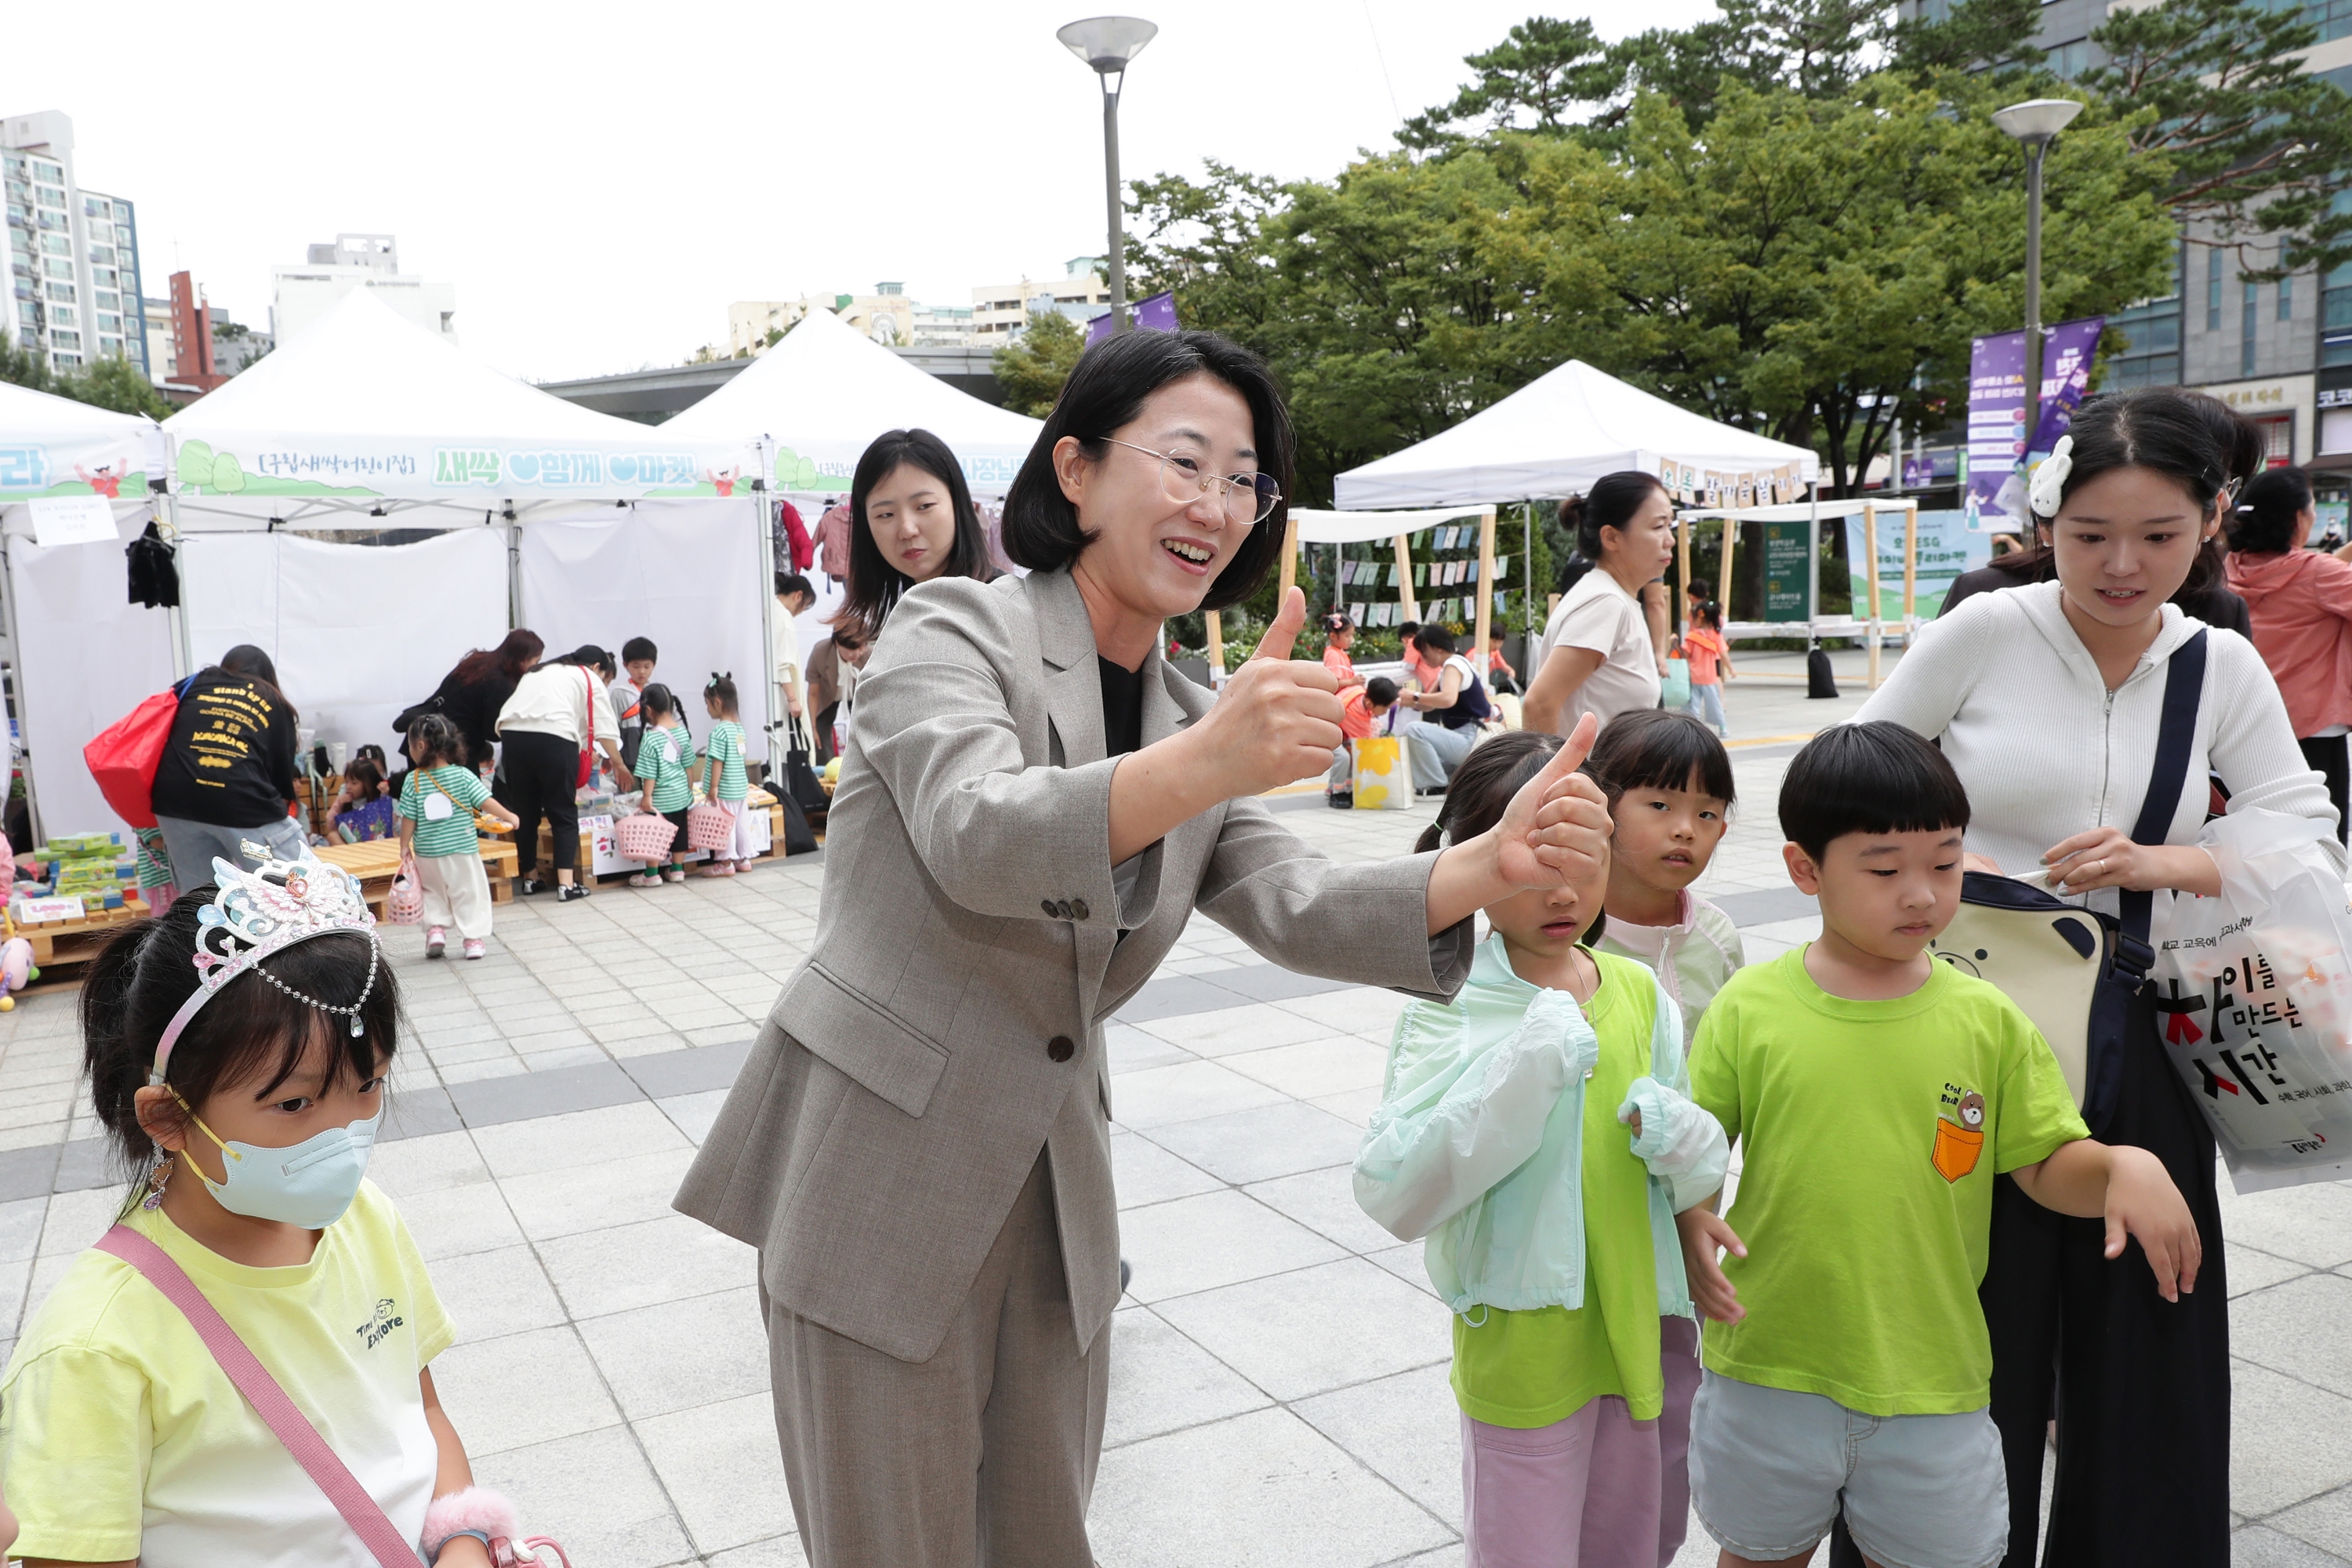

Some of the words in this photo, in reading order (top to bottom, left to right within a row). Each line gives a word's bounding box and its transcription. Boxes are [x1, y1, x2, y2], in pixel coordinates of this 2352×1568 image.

[437, 451, 501, 484] 새싹
[539, 453, 601, 484] 함께
[638, 455, 699, 485] 마켓
[2183, 937, 2217, 948] 교육에
[2232, 997, 2303, 1039] 만드는
[2191, 1044, 2286, 1105] 시간
[368, 1316, 403, 1349] Explore
